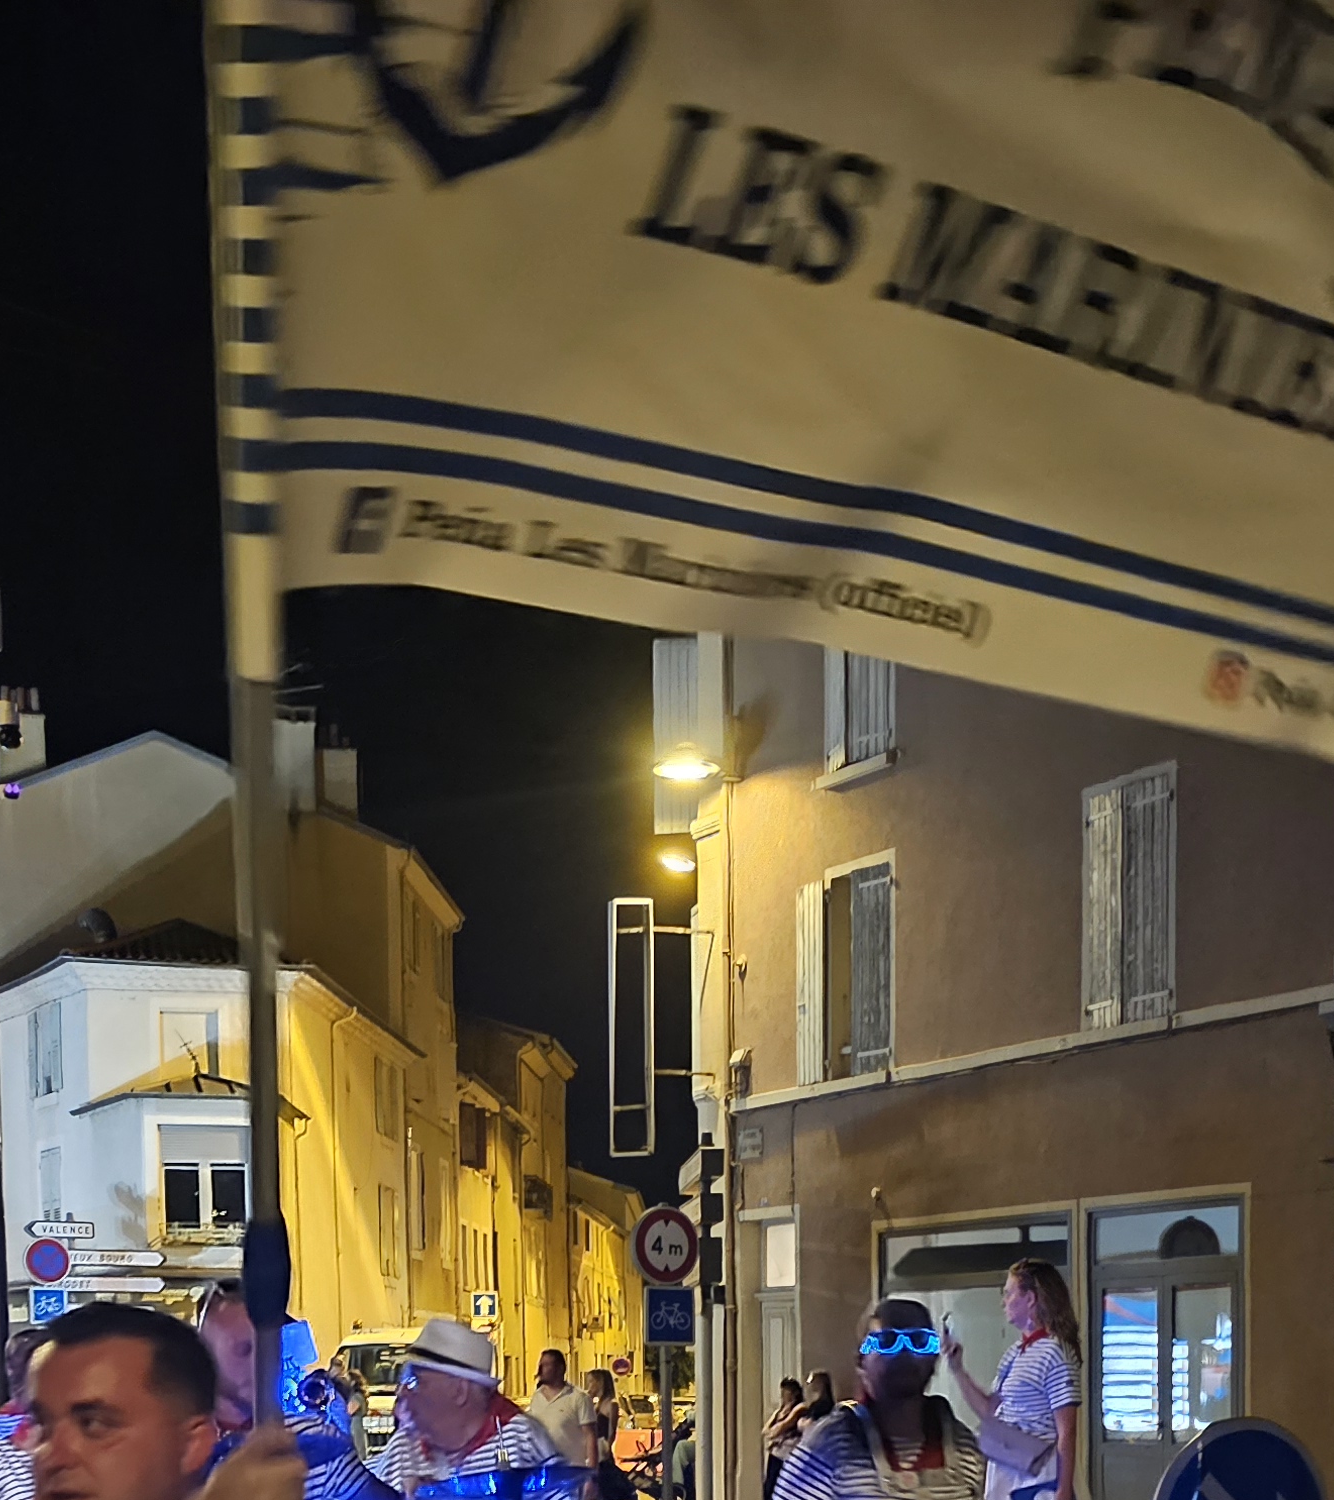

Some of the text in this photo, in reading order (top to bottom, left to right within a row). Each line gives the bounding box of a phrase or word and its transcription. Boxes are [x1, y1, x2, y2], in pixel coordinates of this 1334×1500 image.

[627, 104, 887, 284] LES
[41, 1225, 90, 1235] VALENCE
[651, 1235, 683, 1256] 4 m
[69, 1252, 93, 1262] EUX
